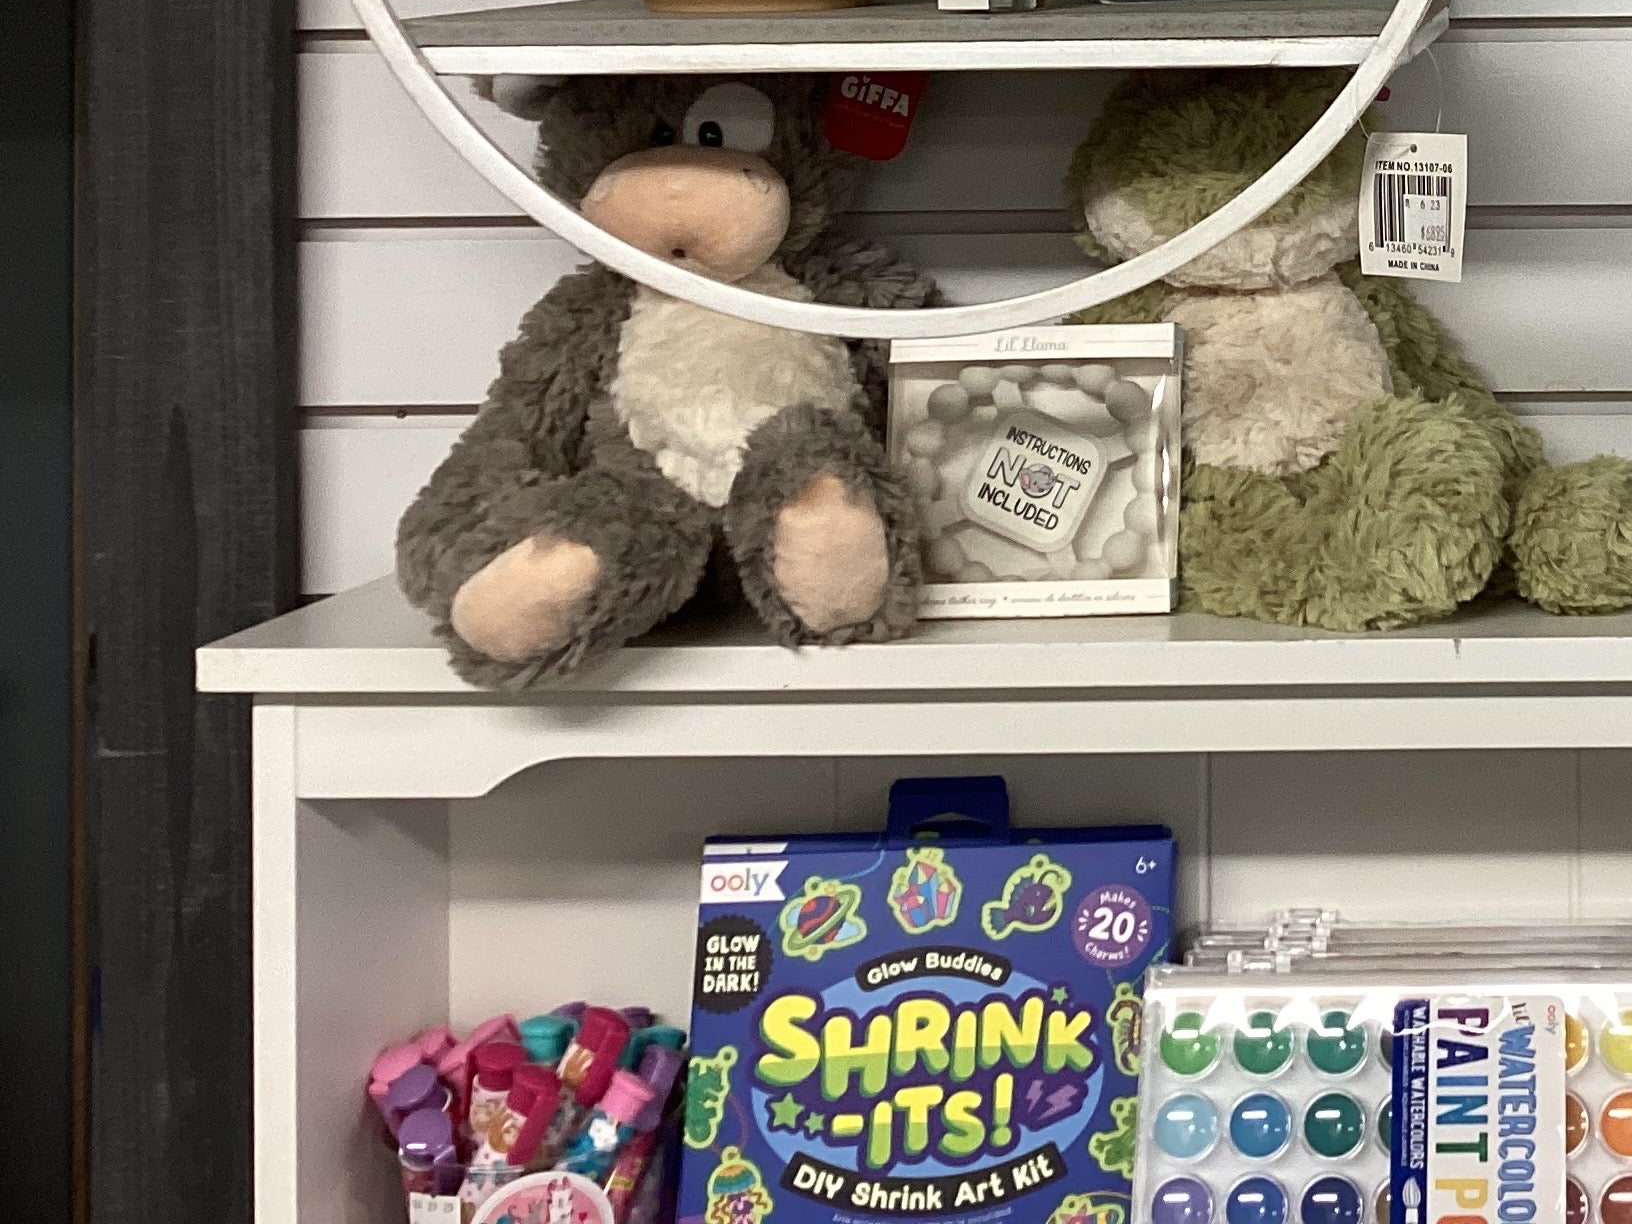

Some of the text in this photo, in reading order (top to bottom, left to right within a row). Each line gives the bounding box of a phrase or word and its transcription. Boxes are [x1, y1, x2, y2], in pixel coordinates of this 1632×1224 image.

[1375, 161, 1395, 171] ITEM
[1388, 260, 1440, 272] MADE IN CHINA
[1006, 426, 1092, 475] INSTRUCTIONS
[977, 482, 1059, 530] INCLUDED
[1135, 856, 1157, 874] 6+
[710, 867, 769, 896] ooly
[1100, 891, 1136, 909] Makes
[1088, 907, 1135, 943] 20
[706, 934, 760, 954] GLOW
[1085, 942, 1130, 960] Charms!
[704, 955, 757, 971] IN THE
[867, 952, 1003, 984] Glow Buddies
[703, 971, 760, 993] DARK!
[755, 993, 1095, 1099] SHRINK
[1435, 1008, 1489, 1163] PAINT
[793, 1154, 1054, 1210] DIY Shrink Art Kit
